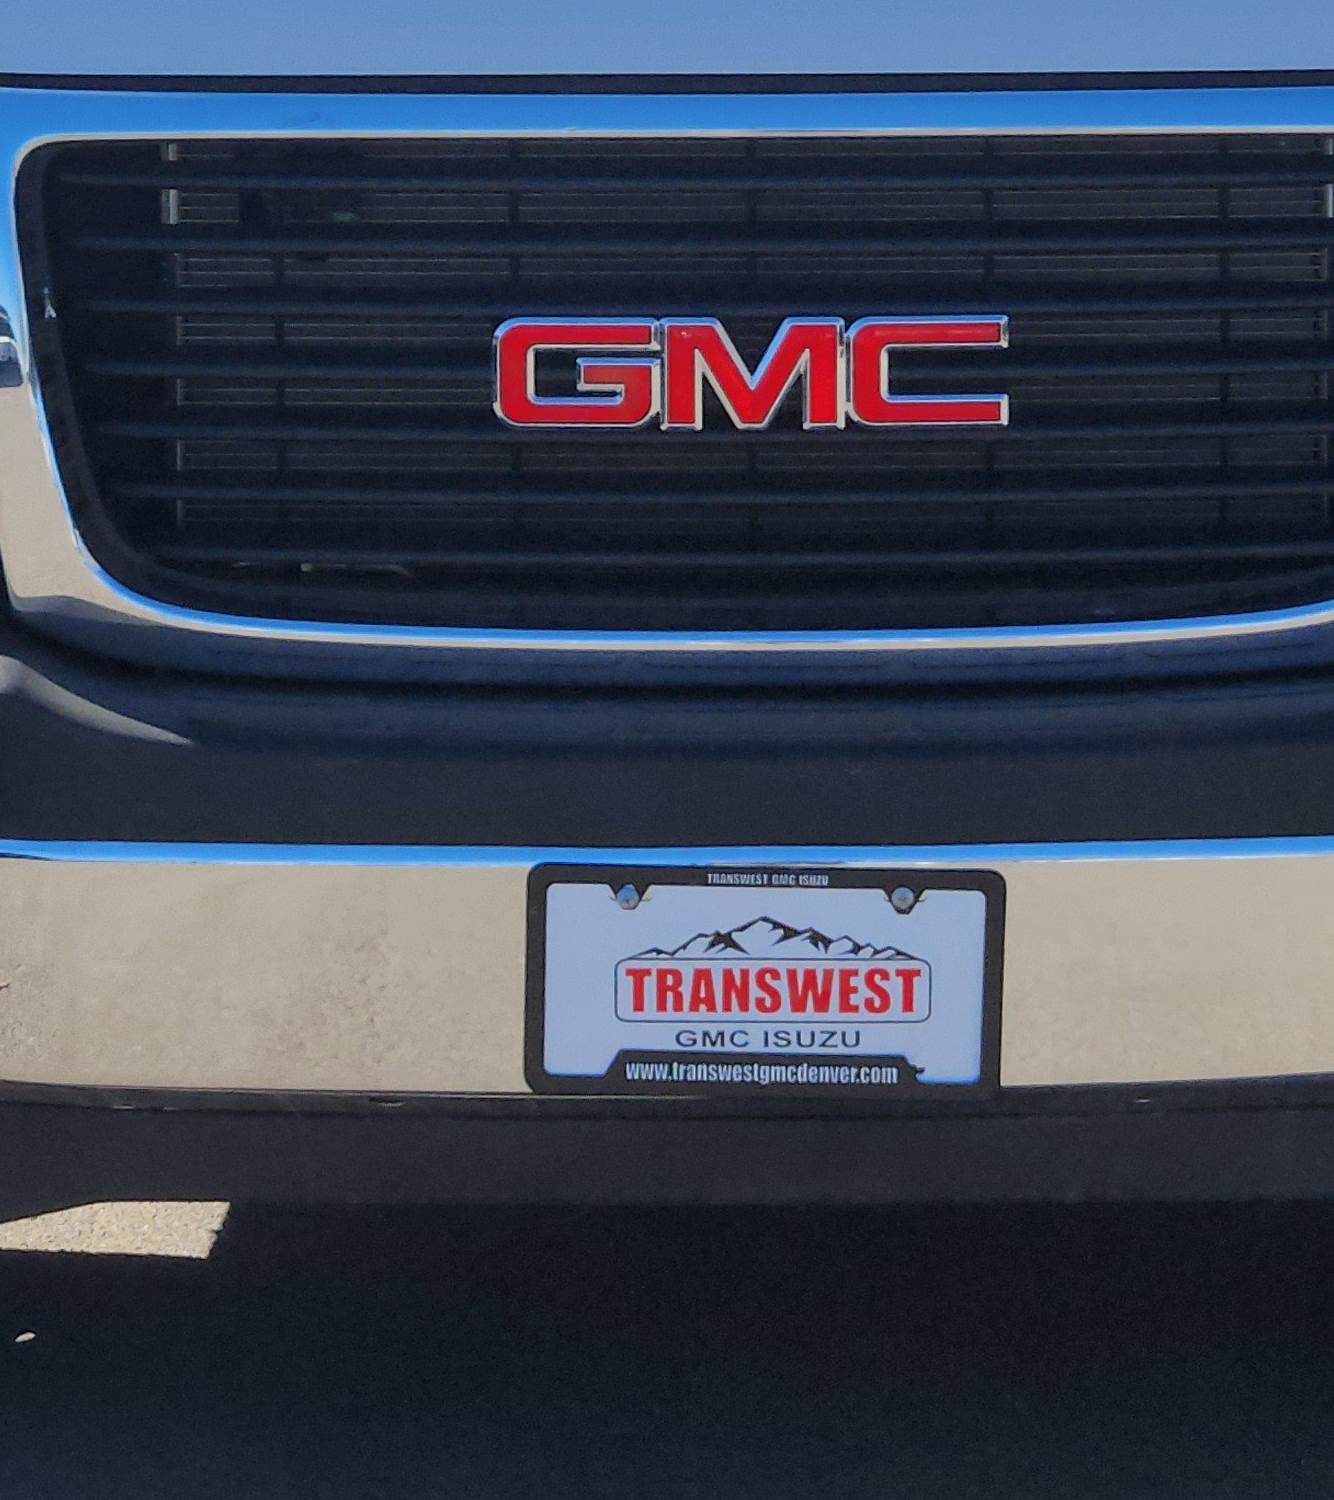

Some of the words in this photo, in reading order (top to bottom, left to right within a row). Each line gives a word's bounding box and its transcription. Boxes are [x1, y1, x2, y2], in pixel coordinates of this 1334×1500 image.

[492, 315, 1009, 430] GMC
[707, 873, 768, 885] TRANSWEST
[771, 874, 796, 885] GMC
[799, 874, 829, 886] ISUZU
[625, 967, 922, 1014] TRANSWEST
[675, 1029, 750, 1048] GMC
[763, 1029, 861, 1049] ISUZU
[625, 1060, 899, 1085] www.transwestgmcdenver.com
